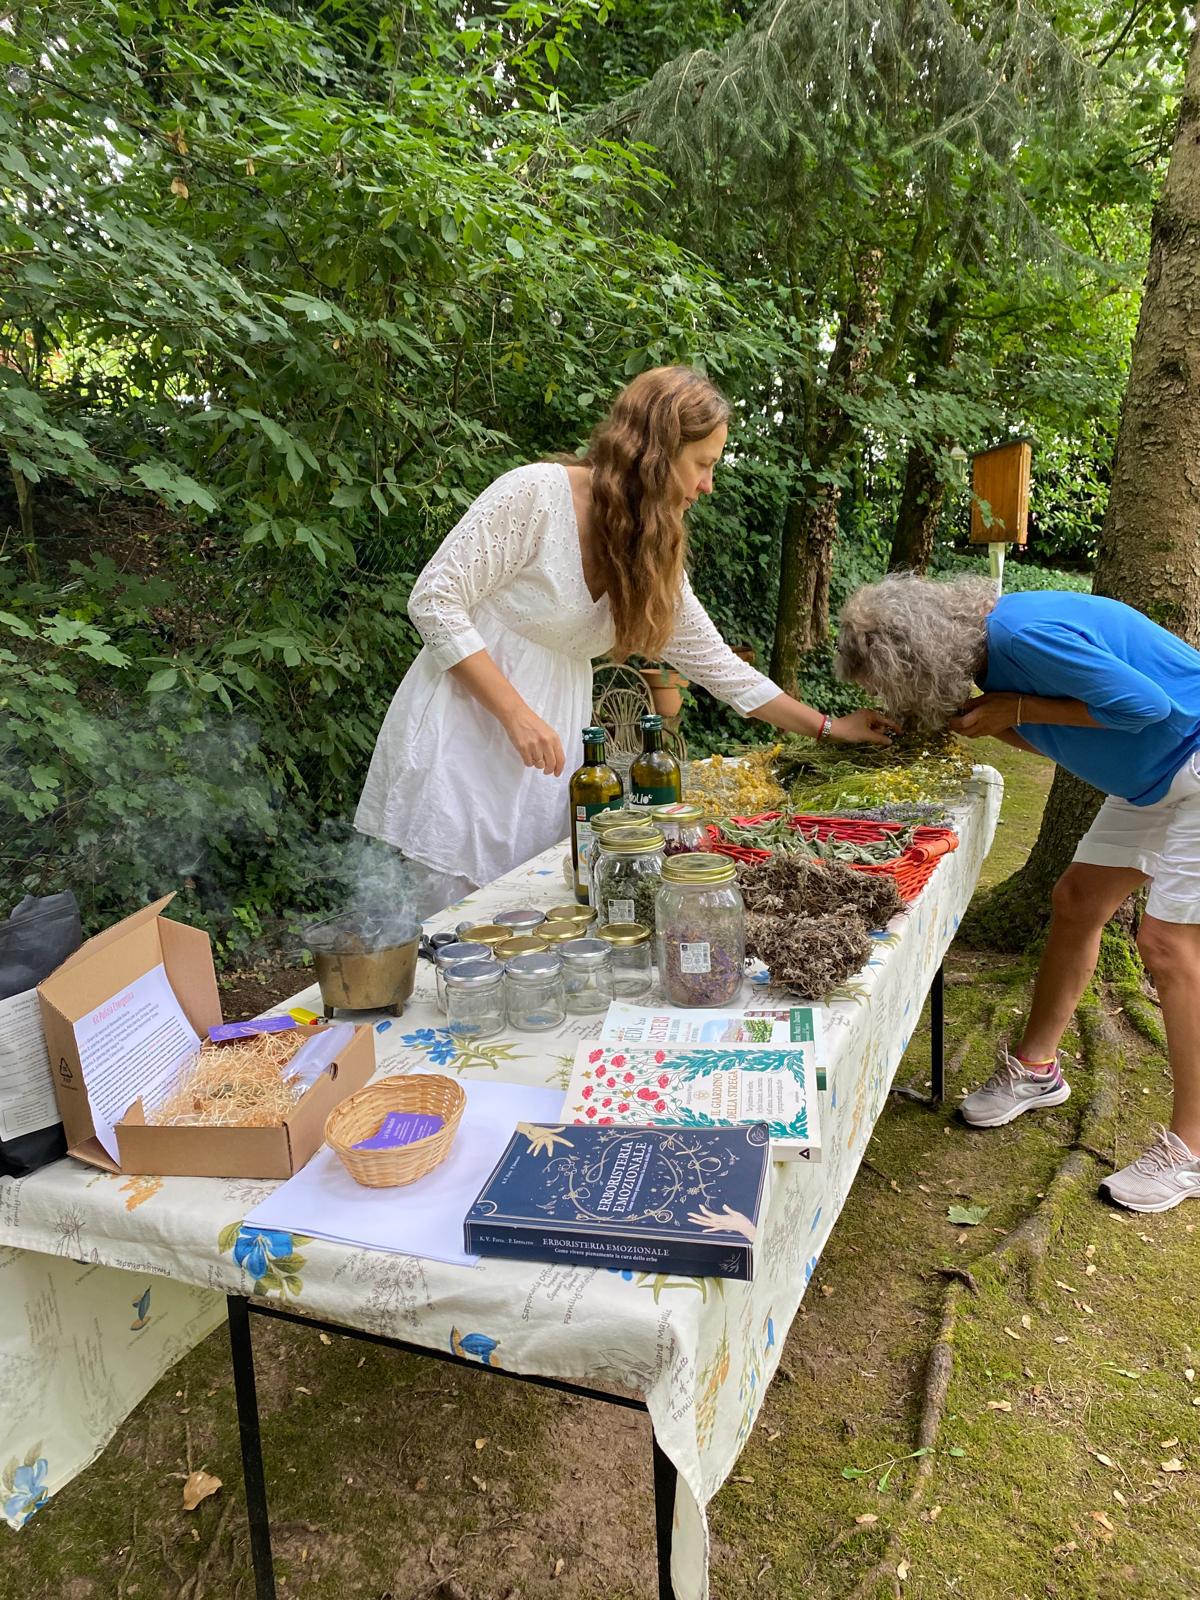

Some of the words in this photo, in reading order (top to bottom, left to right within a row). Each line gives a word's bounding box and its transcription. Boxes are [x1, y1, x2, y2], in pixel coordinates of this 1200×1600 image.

[711, 1072, 723, 1109] GIARDINO
[727, 1070, 738, 1098] STREGA
[727, 1098, 737, 1119] DELLA
[597, 1141, 633, 1212] ERBORISTERIA
[612, 1142, 647, 1213] EMOZIONALE
[542, 1238, 605, 1250] ERBORISTERIA
[606, 1243, 670, 1256] EMOZIONALE
[585, 1250, 614, 1258] pienamente
